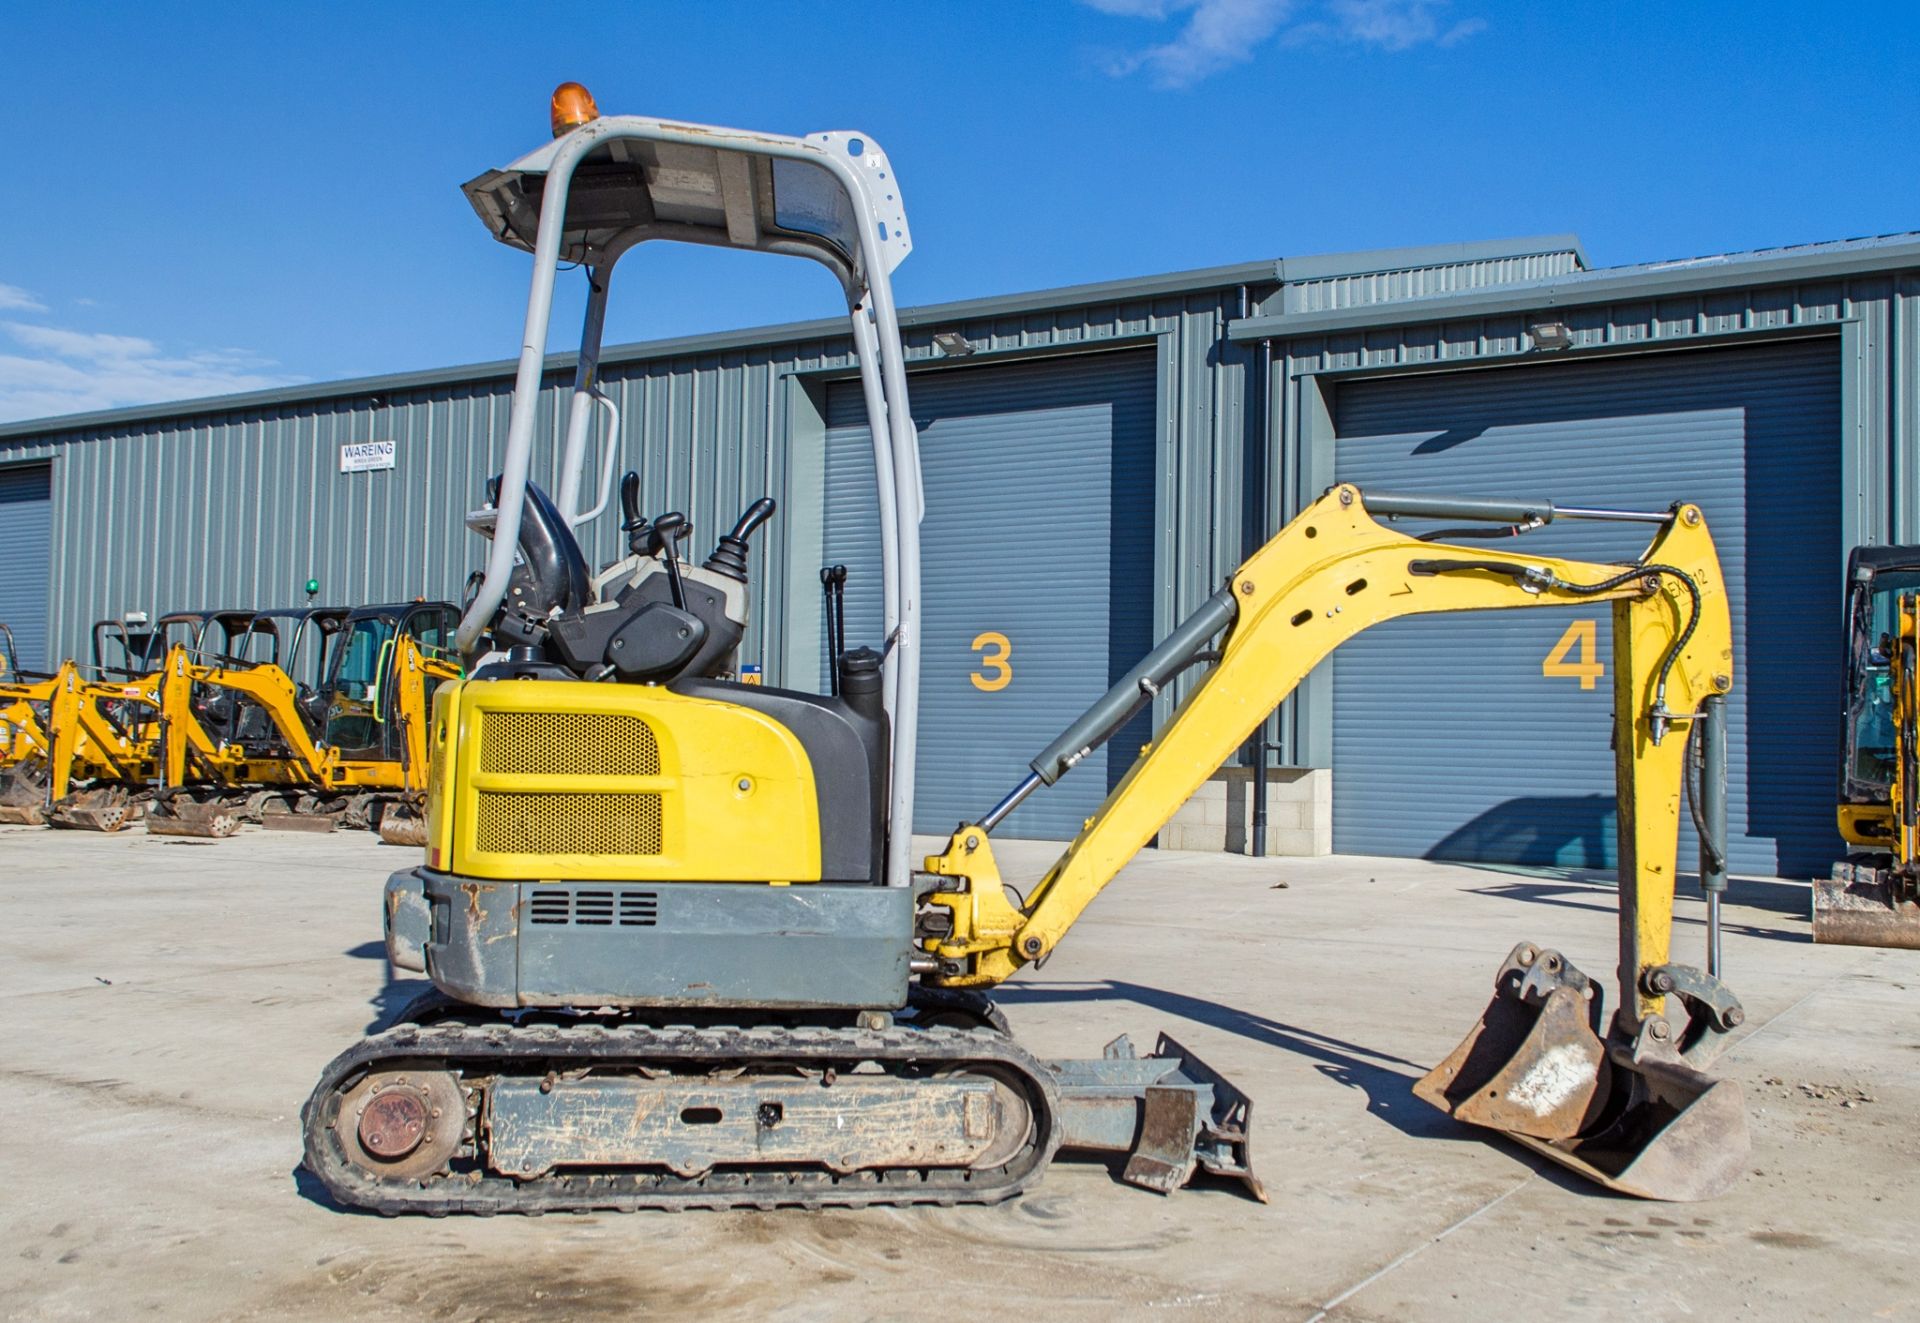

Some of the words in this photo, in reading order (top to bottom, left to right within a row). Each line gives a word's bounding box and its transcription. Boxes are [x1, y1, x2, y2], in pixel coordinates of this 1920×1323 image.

[345, 443, 393, 458] WAREING
[970, 631, 1012, 692] 3
[1543, 620, 1604, 690] 4
